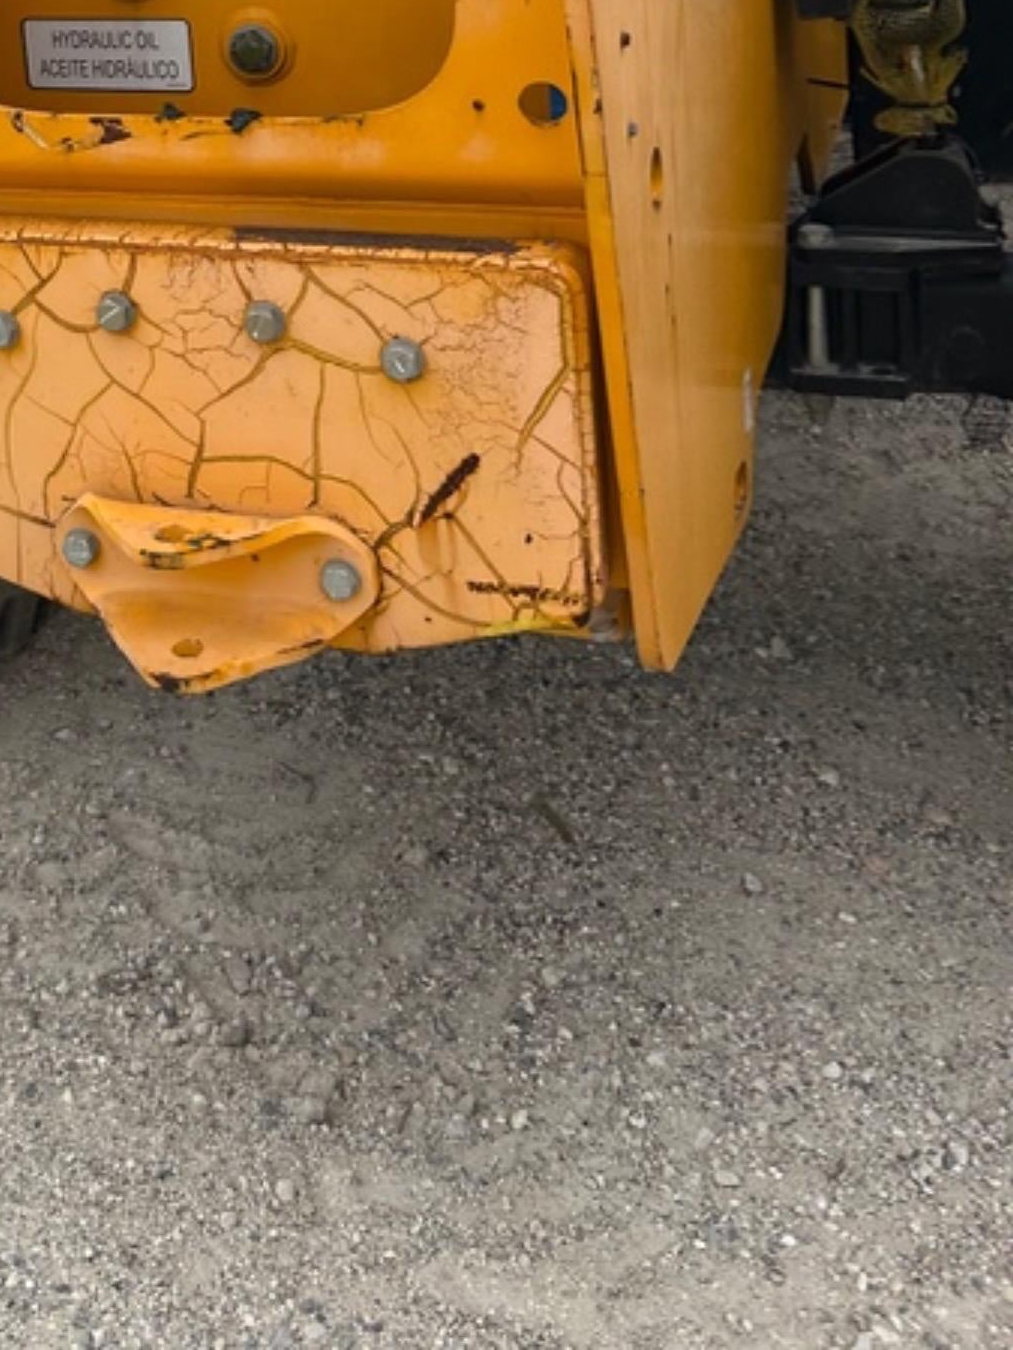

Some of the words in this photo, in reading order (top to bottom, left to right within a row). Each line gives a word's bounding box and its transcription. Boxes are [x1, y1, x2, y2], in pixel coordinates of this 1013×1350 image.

[51, 30, 132, 49] HYDRAULIC
[137, 30, 160, 50] OIL
[40, 59, 88, 79] ACEITE
